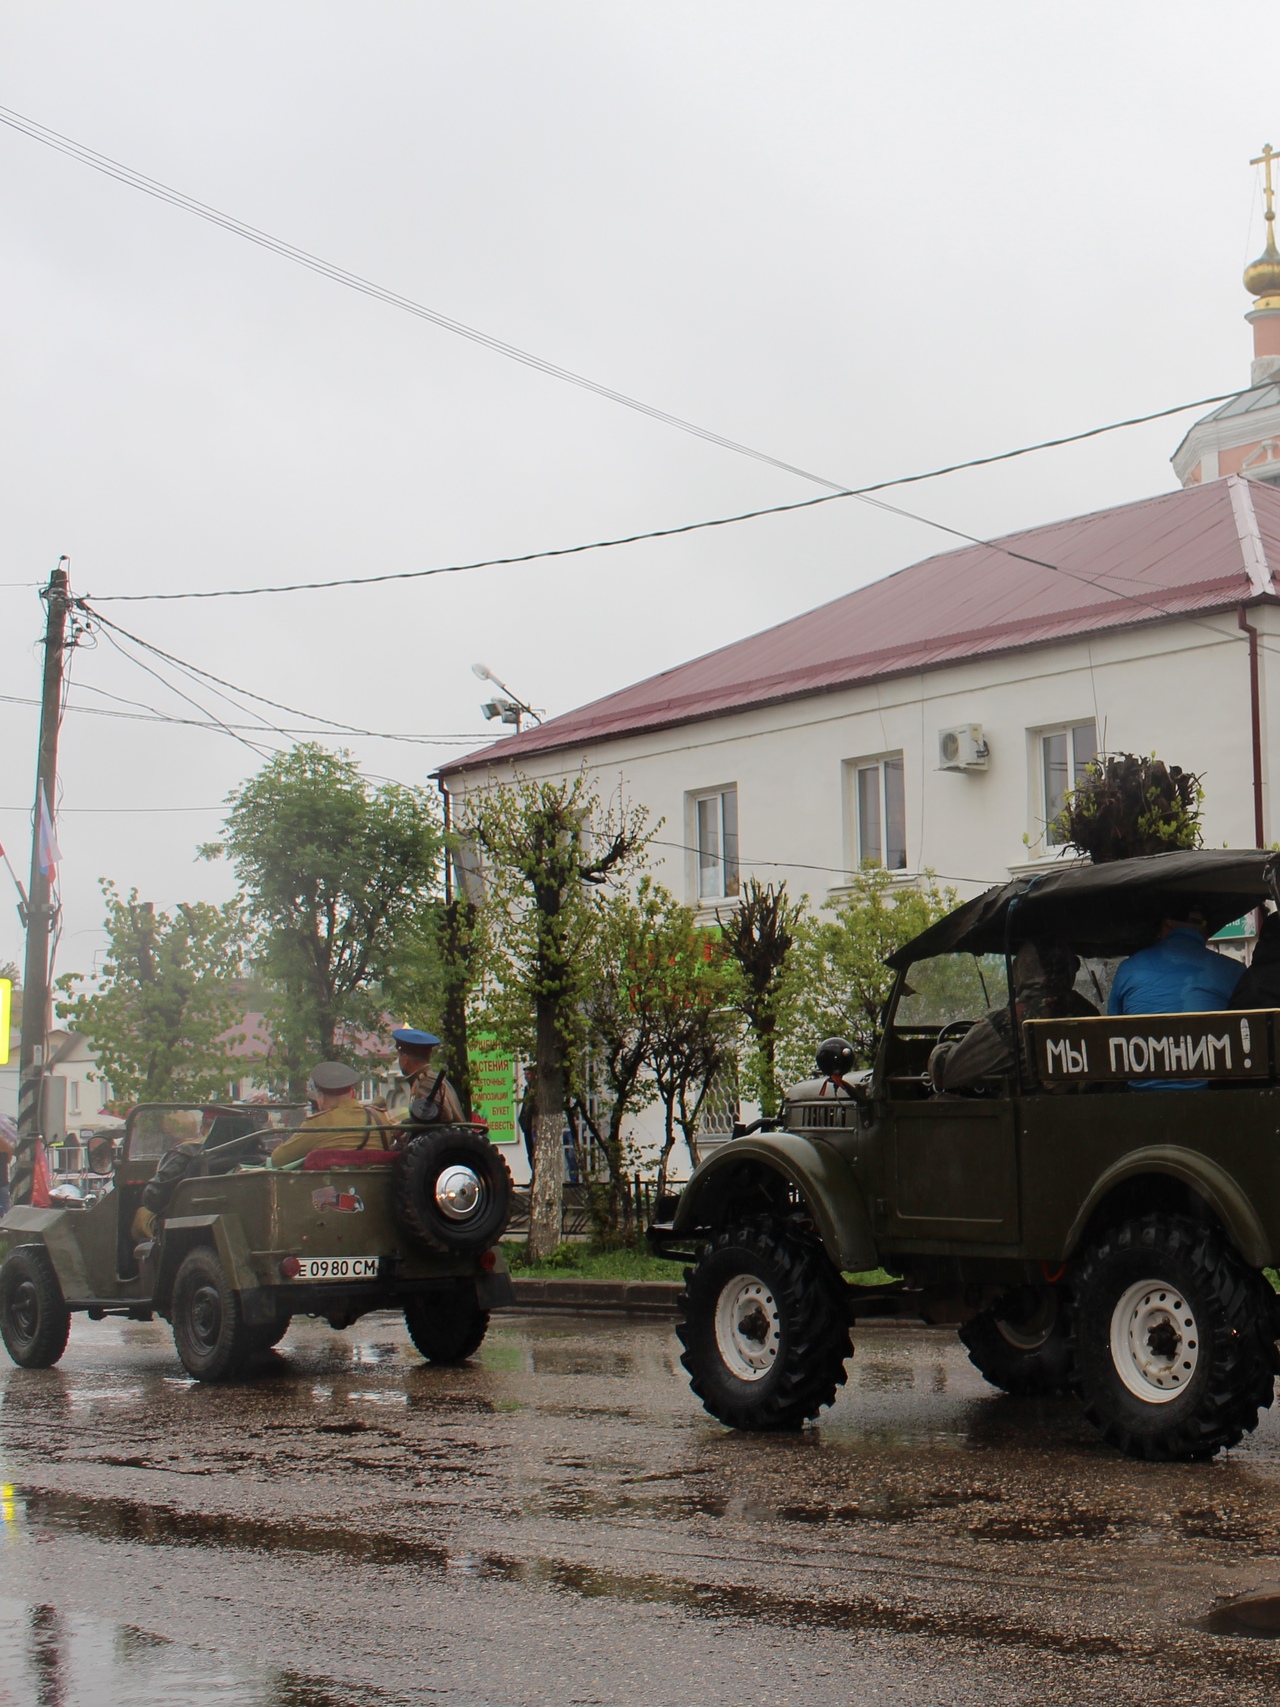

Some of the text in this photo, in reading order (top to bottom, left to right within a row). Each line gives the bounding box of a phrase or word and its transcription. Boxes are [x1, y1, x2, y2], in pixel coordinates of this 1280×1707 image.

[1046, 1038, 1089, 1074] МЫ
[472, 1060, 509, 1072] АСТЕНИЯ
[492, 1106, 510, 1116] БУКЕТ
[310, 1260, 349, 1277] 0980
[353, 1259, 376, 1276] СМ
